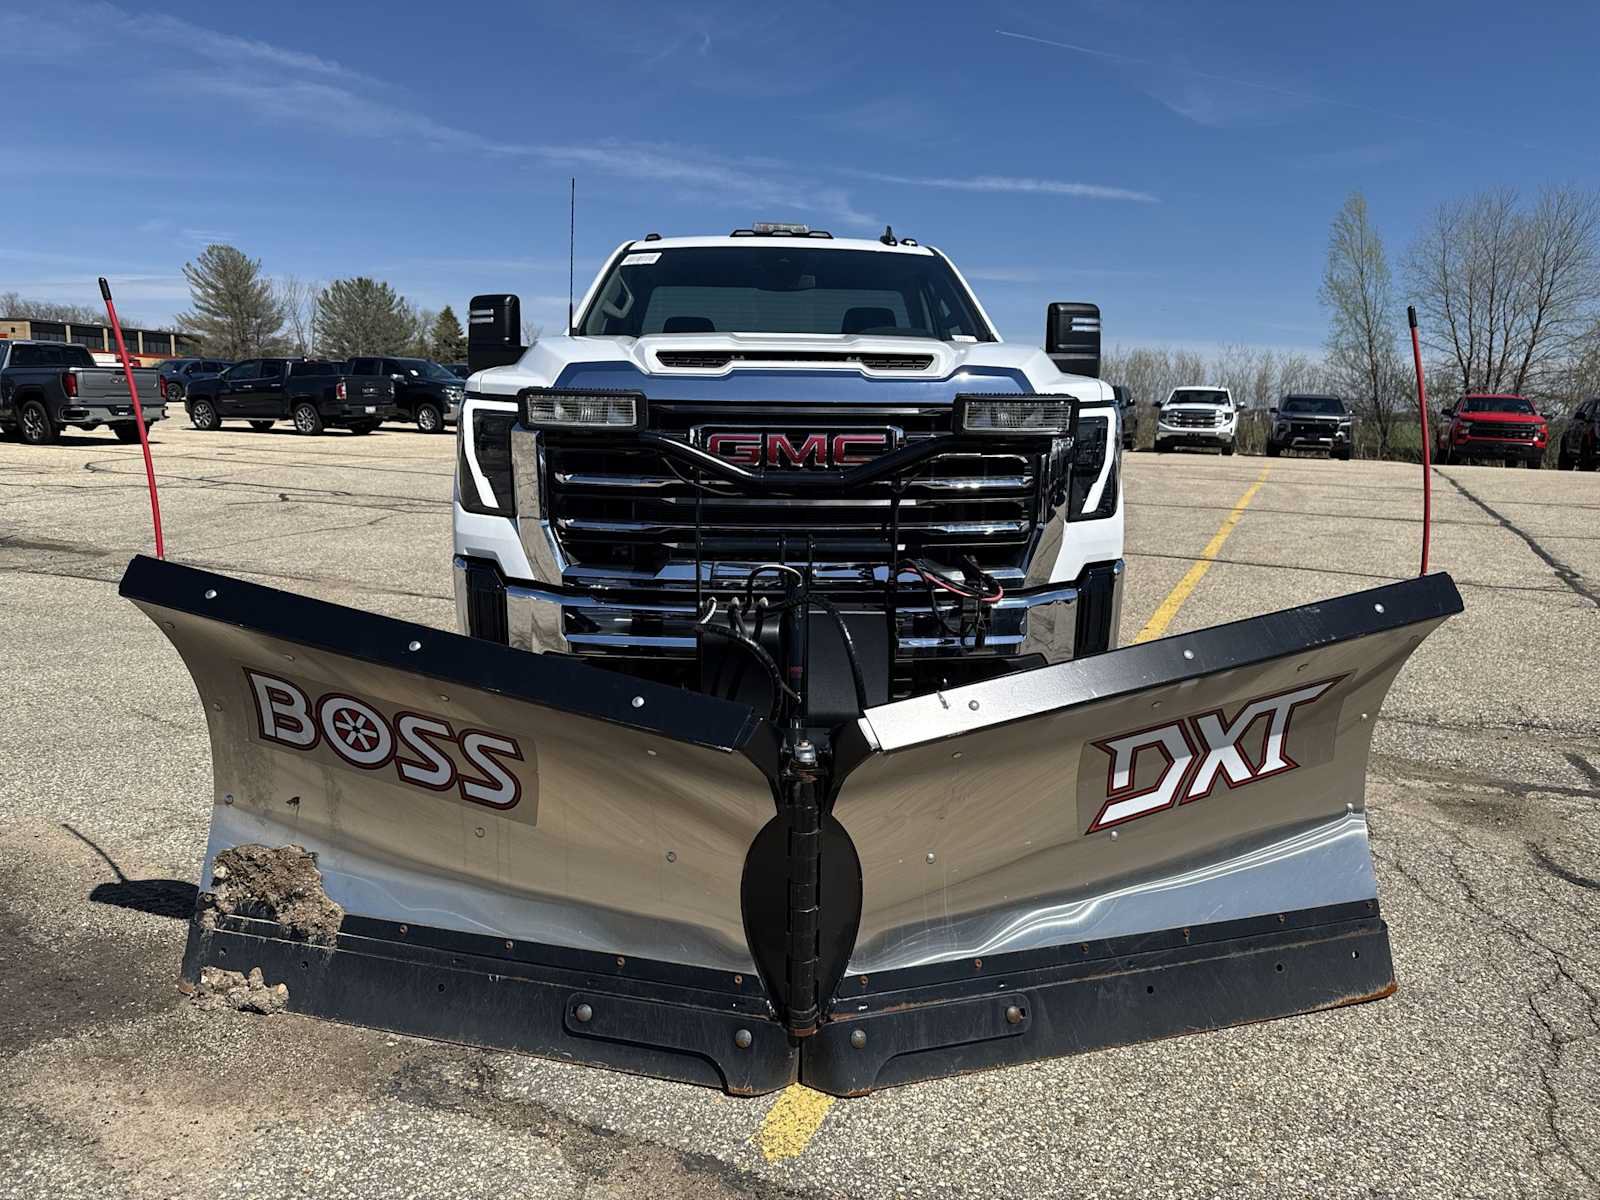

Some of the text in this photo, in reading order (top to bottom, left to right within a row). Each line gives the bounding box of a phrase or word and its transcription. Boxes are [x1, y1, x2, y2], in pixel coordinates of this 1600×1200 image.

[707, 433, 886, 468] GMC
[245, 669, 523, 810] BOSS
[1086, 673, 1351, 835] DXT
